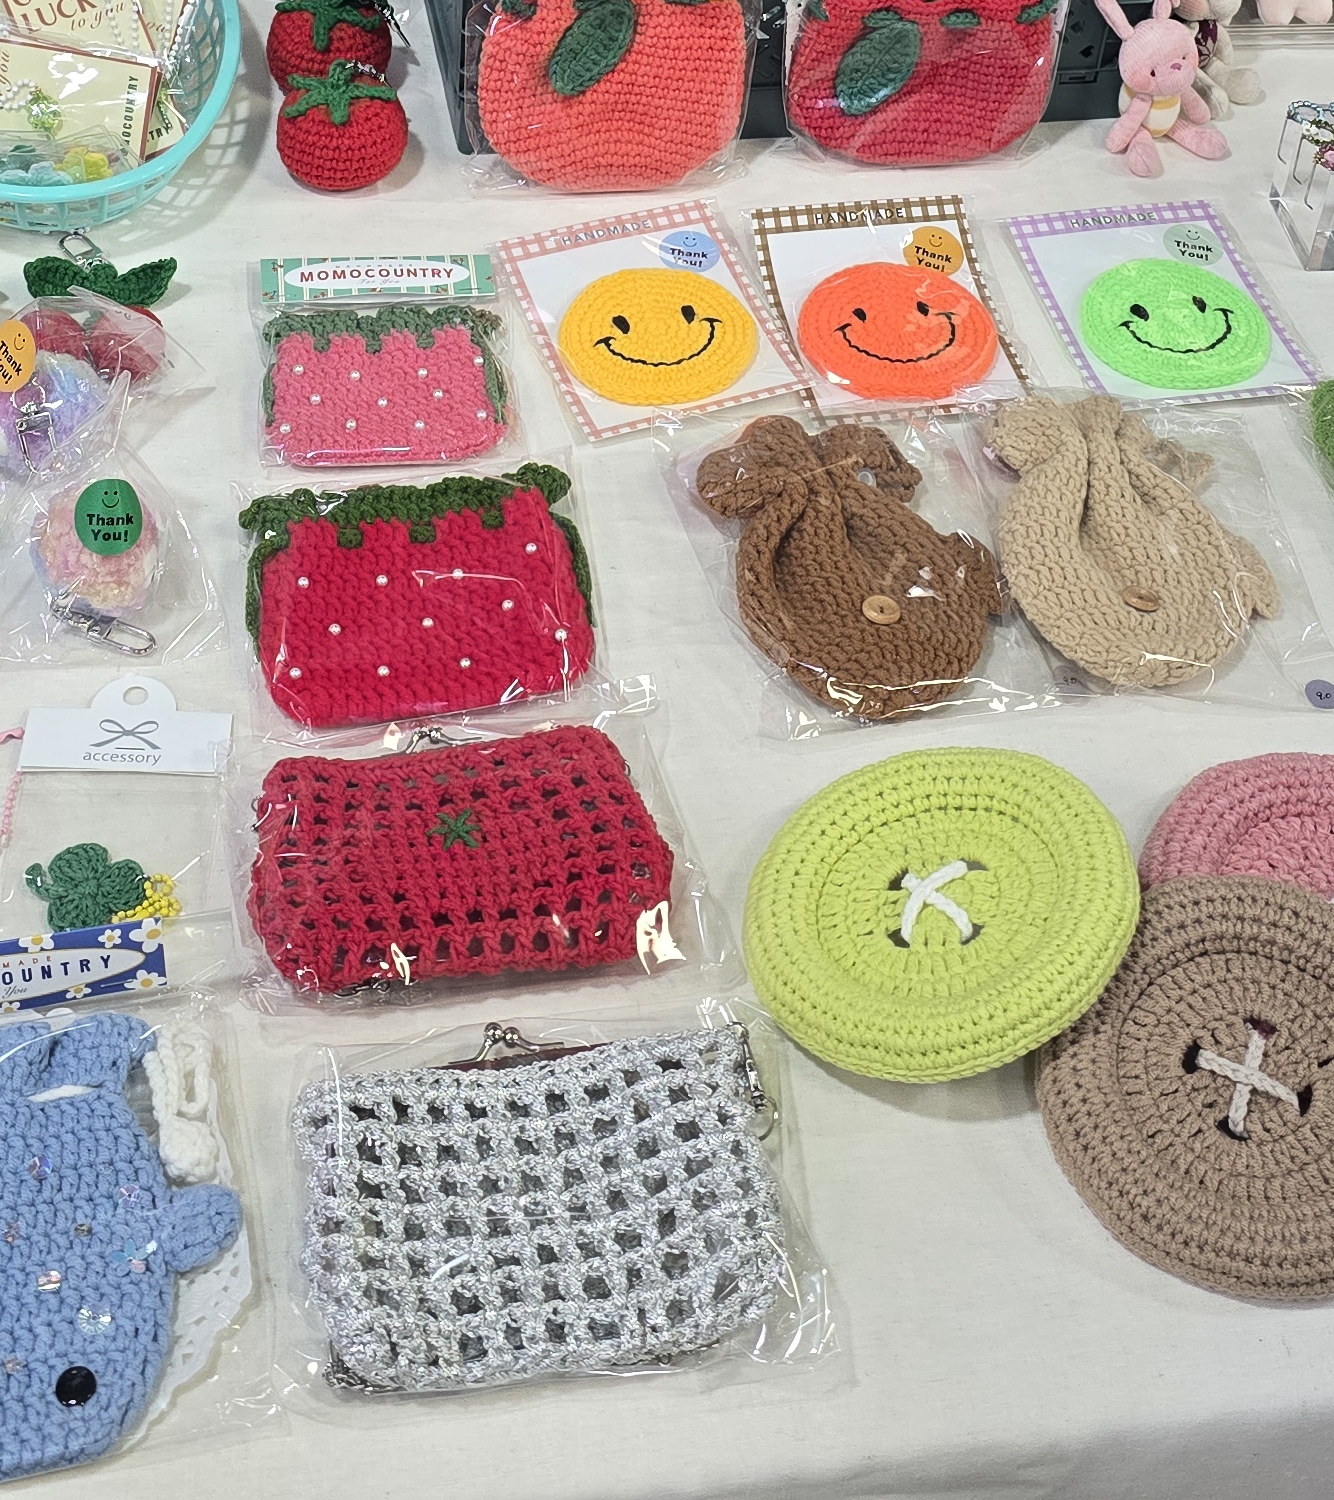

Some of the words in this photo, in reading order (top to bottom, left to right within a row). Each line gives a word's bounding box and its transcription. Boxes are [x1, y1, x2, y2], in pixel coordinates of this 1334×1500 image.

[70, 17, 88, 33] to
[814, 206, 906, 225] HANDMADE
[1069, 212, 1157, 229] HANDMADE
[561, 218, 652, 248] HANDMADE
[669, 246, 709, 261] Thank
[914, 244, 953, 264] Thank
[1174, 240, 1214, 253] Thank
[672, 256, 704, 269] You!
[1178, 249, 1210, 262] You!
[915, 257, 947, 273] You!
[299, 268, 455, 283] MOMOCOUNTRY
[86, 512, 135, 528] Thank
[90, 528, 129, 543] You!
[83, 750, 162, 767] accessory
[4, 985, 28, 999] You
